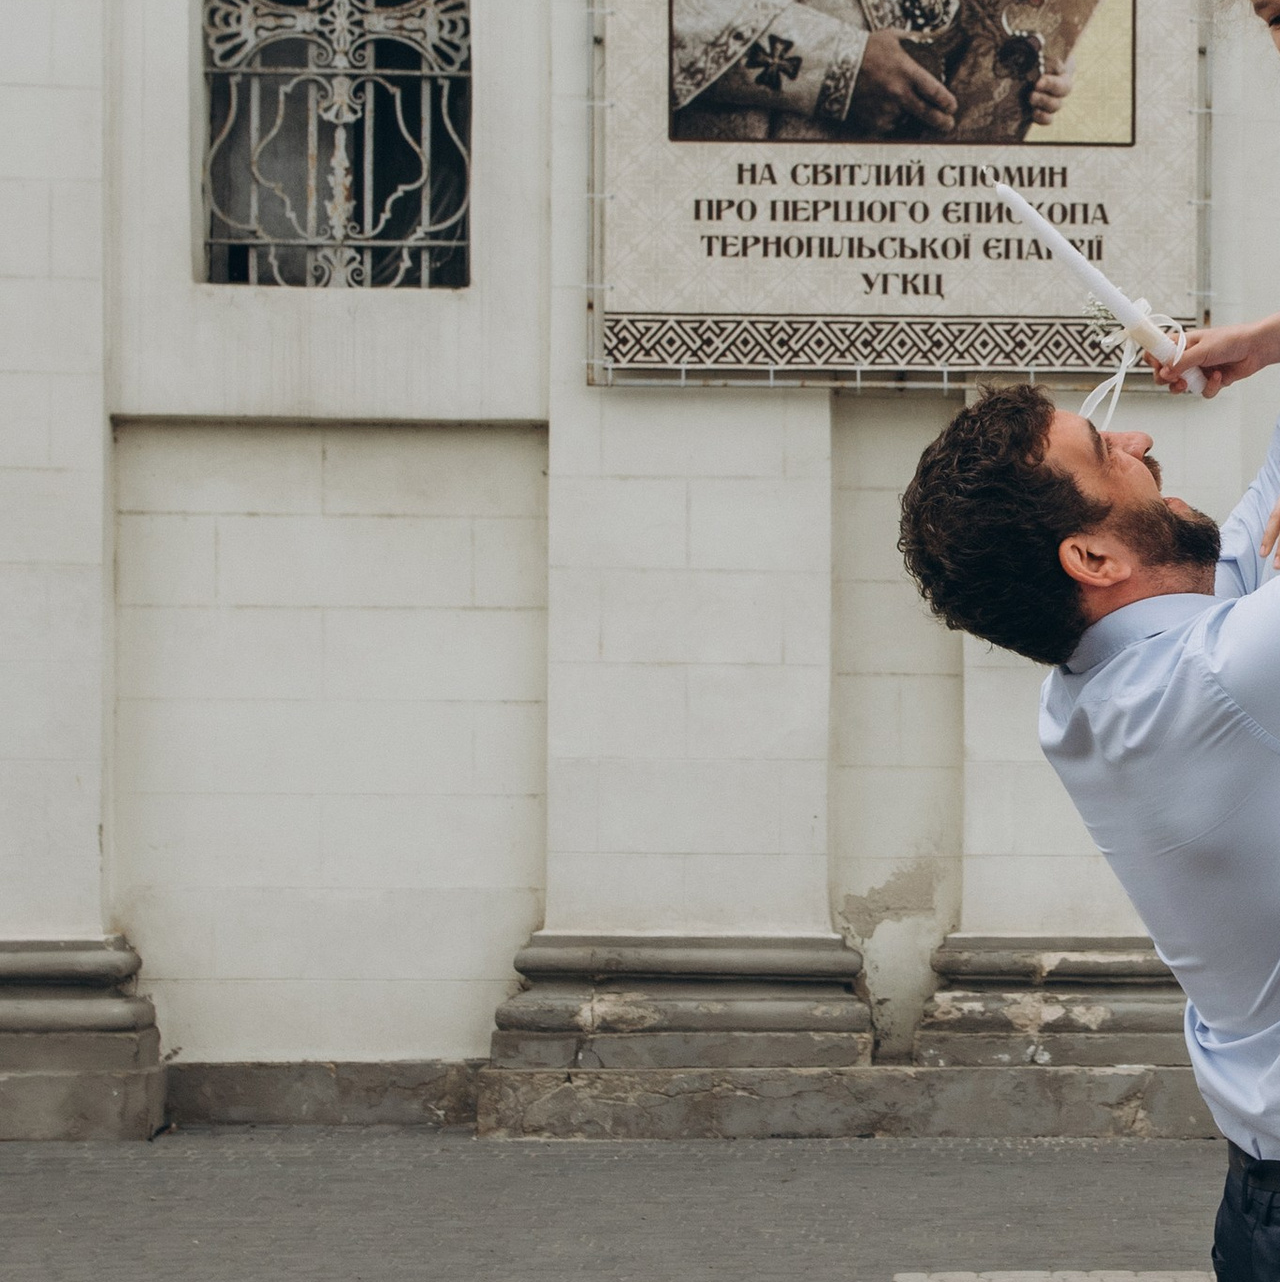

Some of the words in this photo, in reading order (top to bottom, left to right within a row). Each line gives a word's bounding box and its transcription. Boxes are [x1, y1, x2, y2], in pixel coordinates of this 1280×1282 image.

[737, 162, 778, 187] НА
[790, 159, 926, 188] СВІТЛИЙ
[936, 164, 1068, 189] СПОМИН
[693, 198, 758, 222] ПРО
[769, 199, 931, 224] ПЕРШОГО
[700, 233, 972, 261] ТЕРНОПІЛЬСЬКОЇ
[982, 235, 1104, 262] ЄПАХІЇ
[860, 272, 945, 300] УГКЦ
